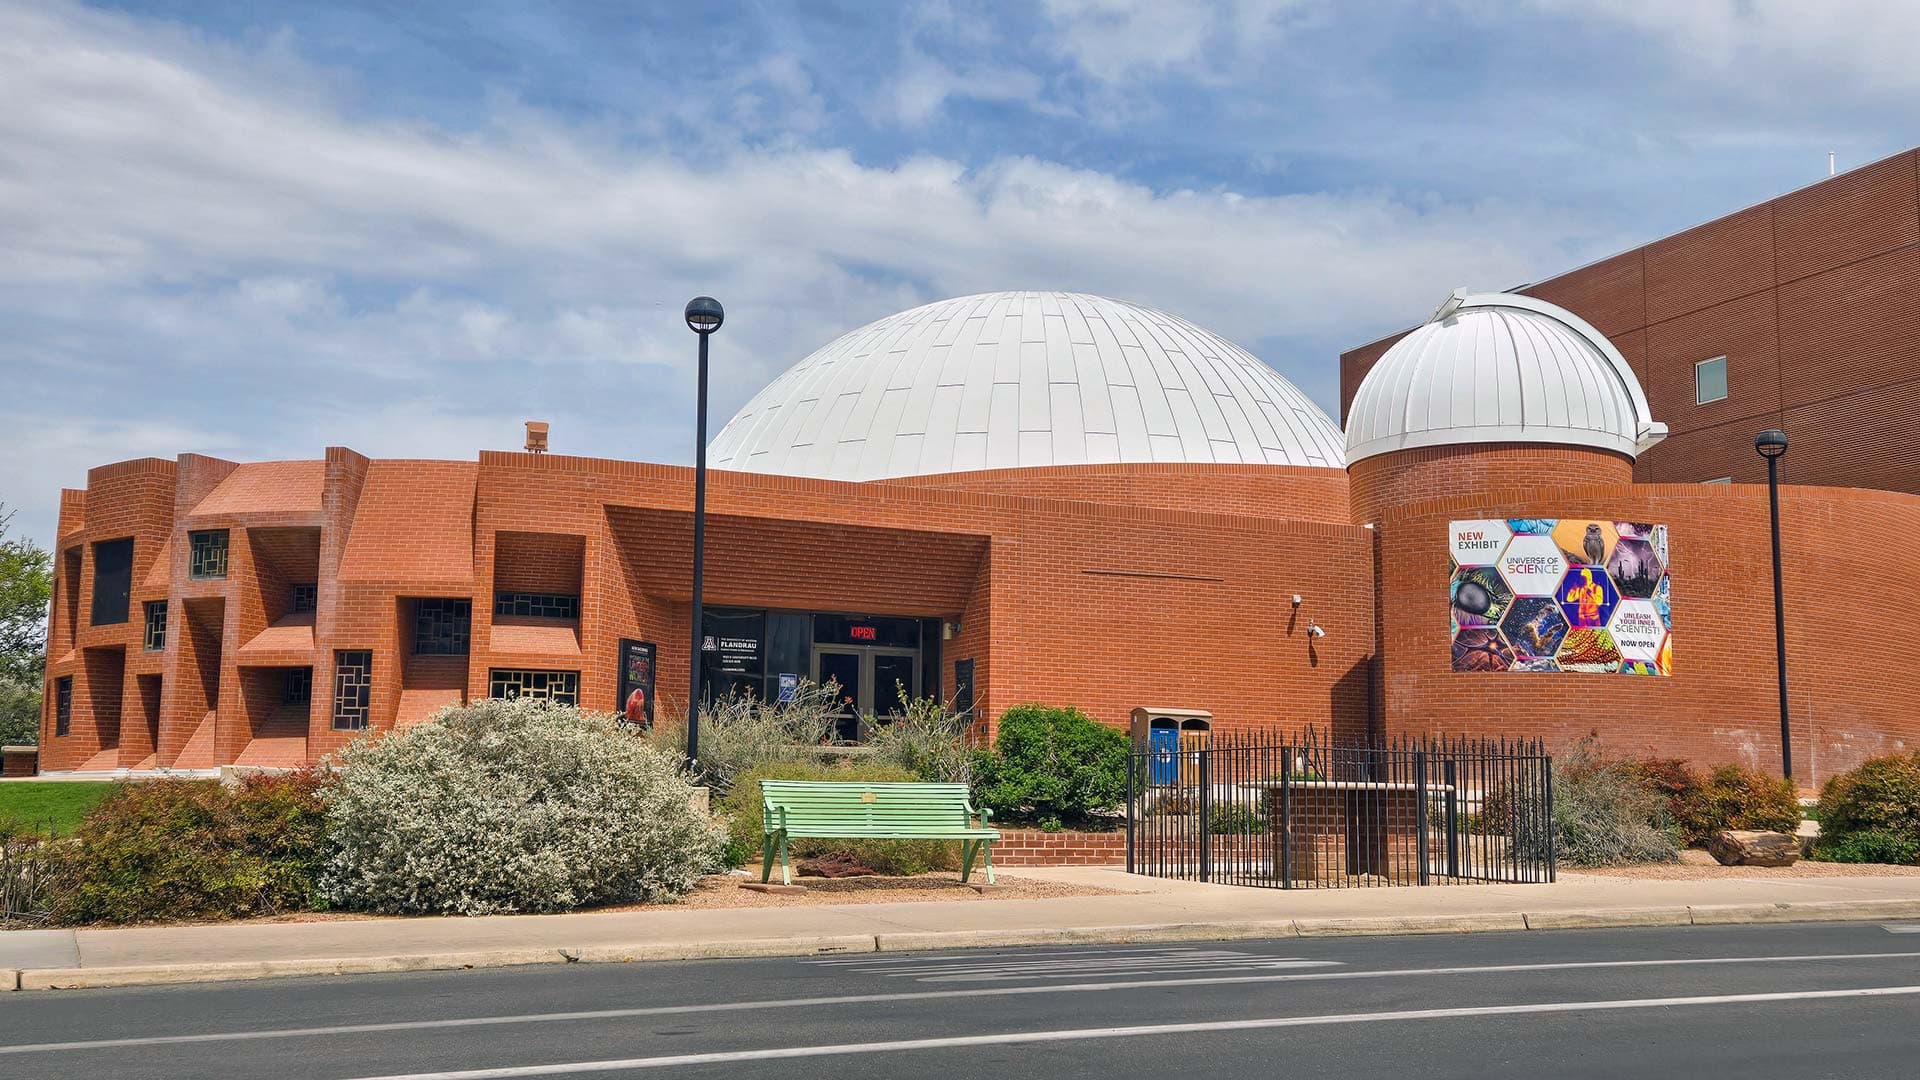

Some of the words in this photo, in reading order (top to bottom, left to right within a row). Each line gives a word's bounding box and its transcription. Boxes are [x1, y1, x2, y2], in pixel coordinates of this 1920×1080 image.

[1458, 532, 1484, 540] NEW
[1458, 540, 1499, 549] EXHIBIT
[1506, 557, 1546, 565] UNIVERSE
[1508, 565, 1559, 574] SCIENCE
[851, 626, 876, 639] OPEN
[1615, 624, 1660, 635] SCIENTIST!
[720, 641, 757, 649] FLANDRAU
